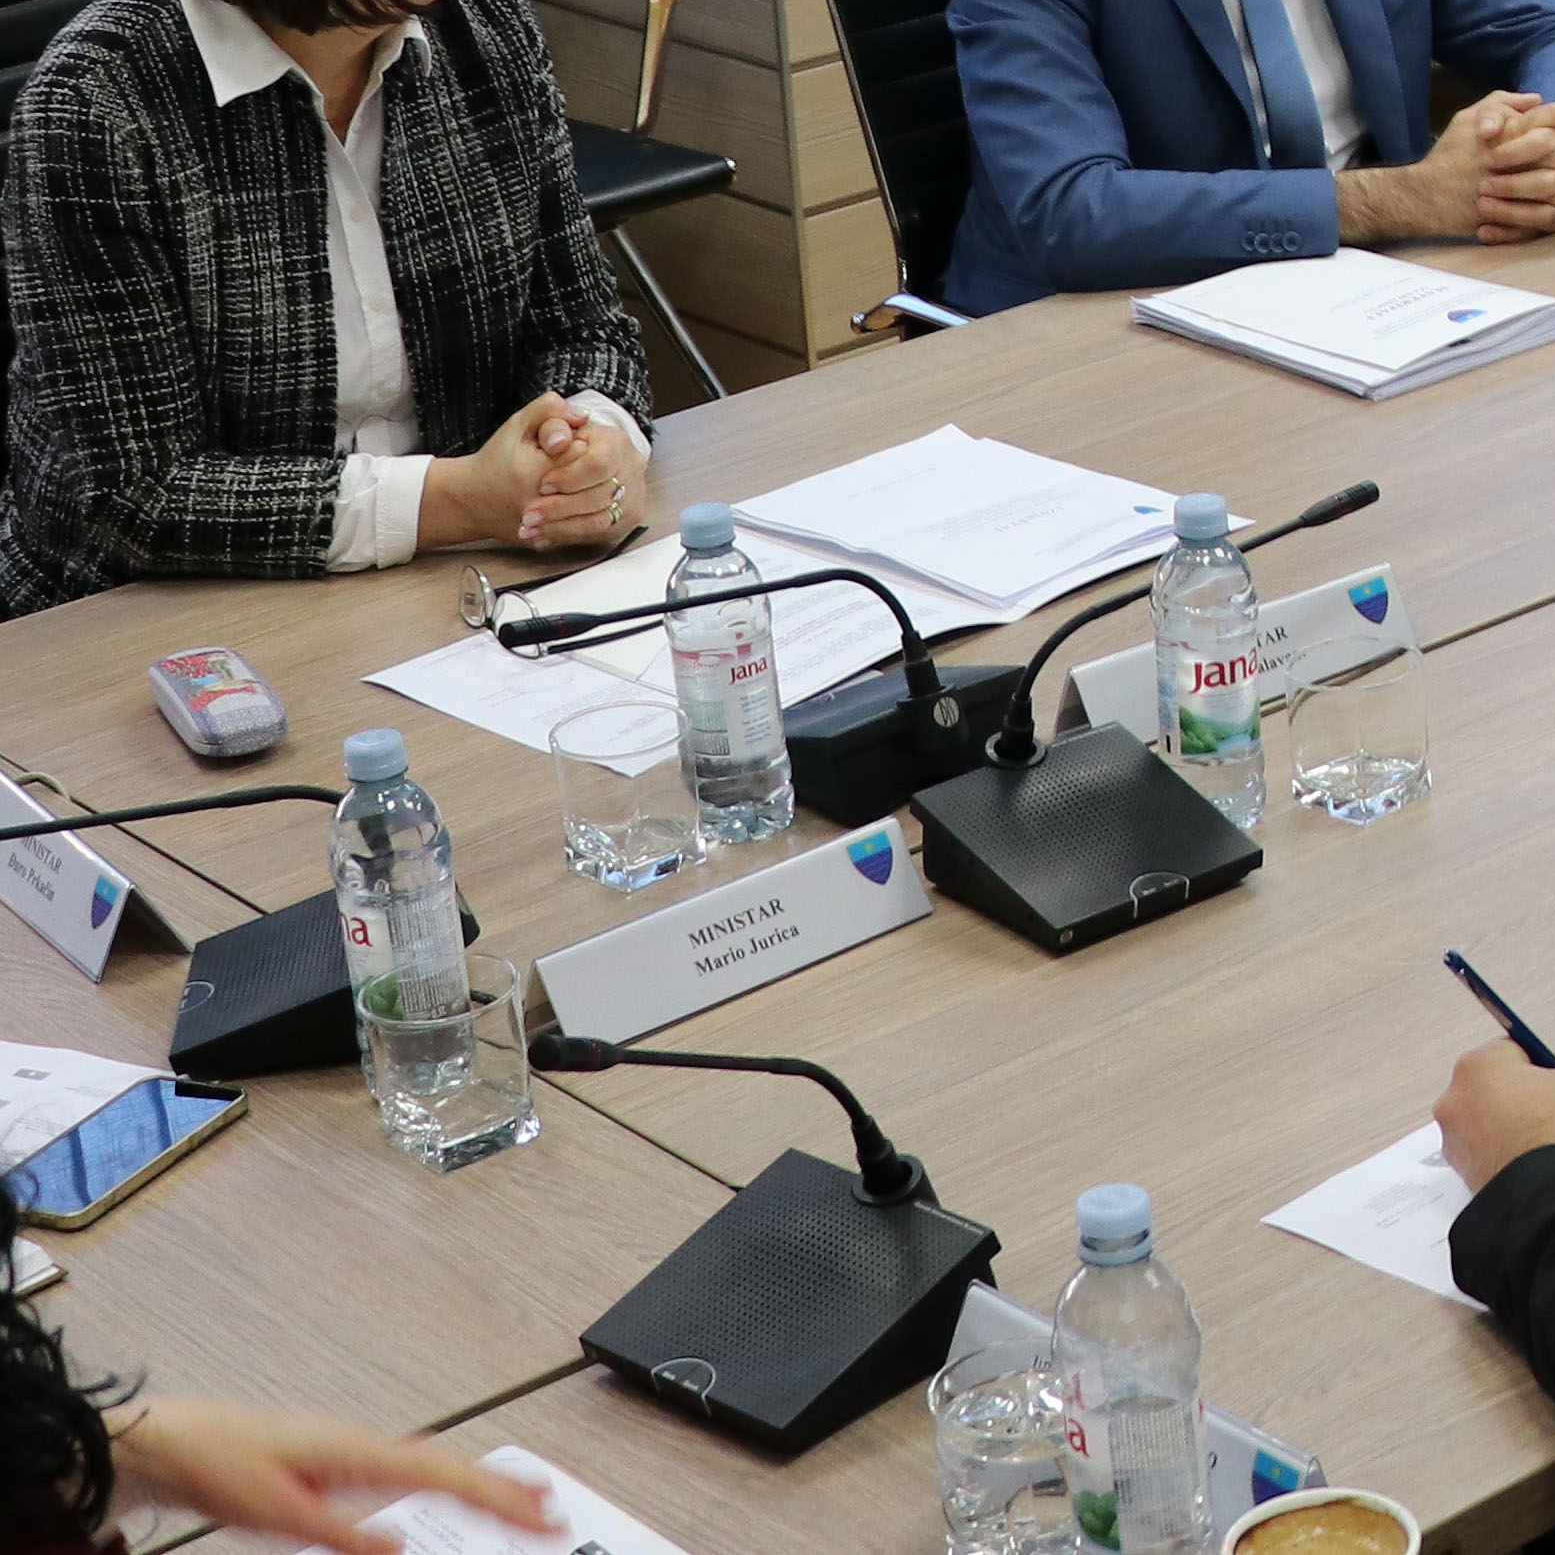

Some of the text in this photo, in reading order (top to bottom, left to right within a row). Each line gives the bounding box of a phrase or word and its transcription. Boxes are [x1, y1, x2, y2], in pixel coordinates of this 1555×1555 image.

[688, 897, 785, 949] MINISTAR
[694, 924, 800, 977] Mario Jurica
